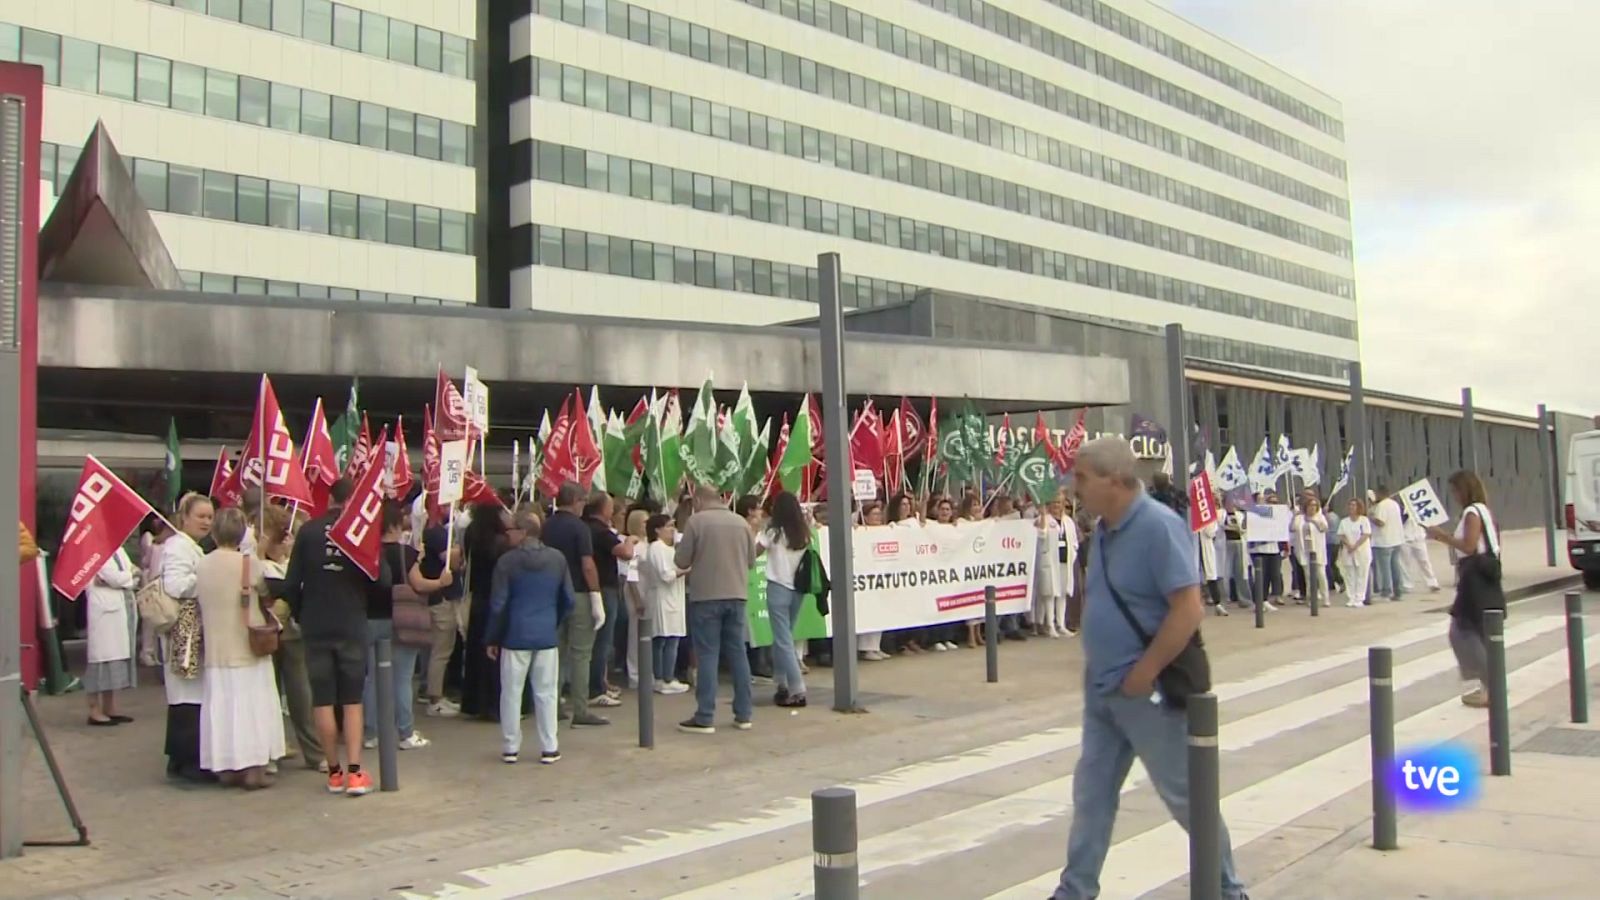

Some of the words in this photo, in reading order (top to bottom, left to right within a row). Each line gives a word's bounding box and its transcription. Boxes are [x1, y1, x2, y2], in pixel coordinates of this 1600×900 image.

[1194, 476, 1211, 522] CCOO
[920, 568, 959, 585] PARA
[964, 561, 1028, 582] AVANZAR
